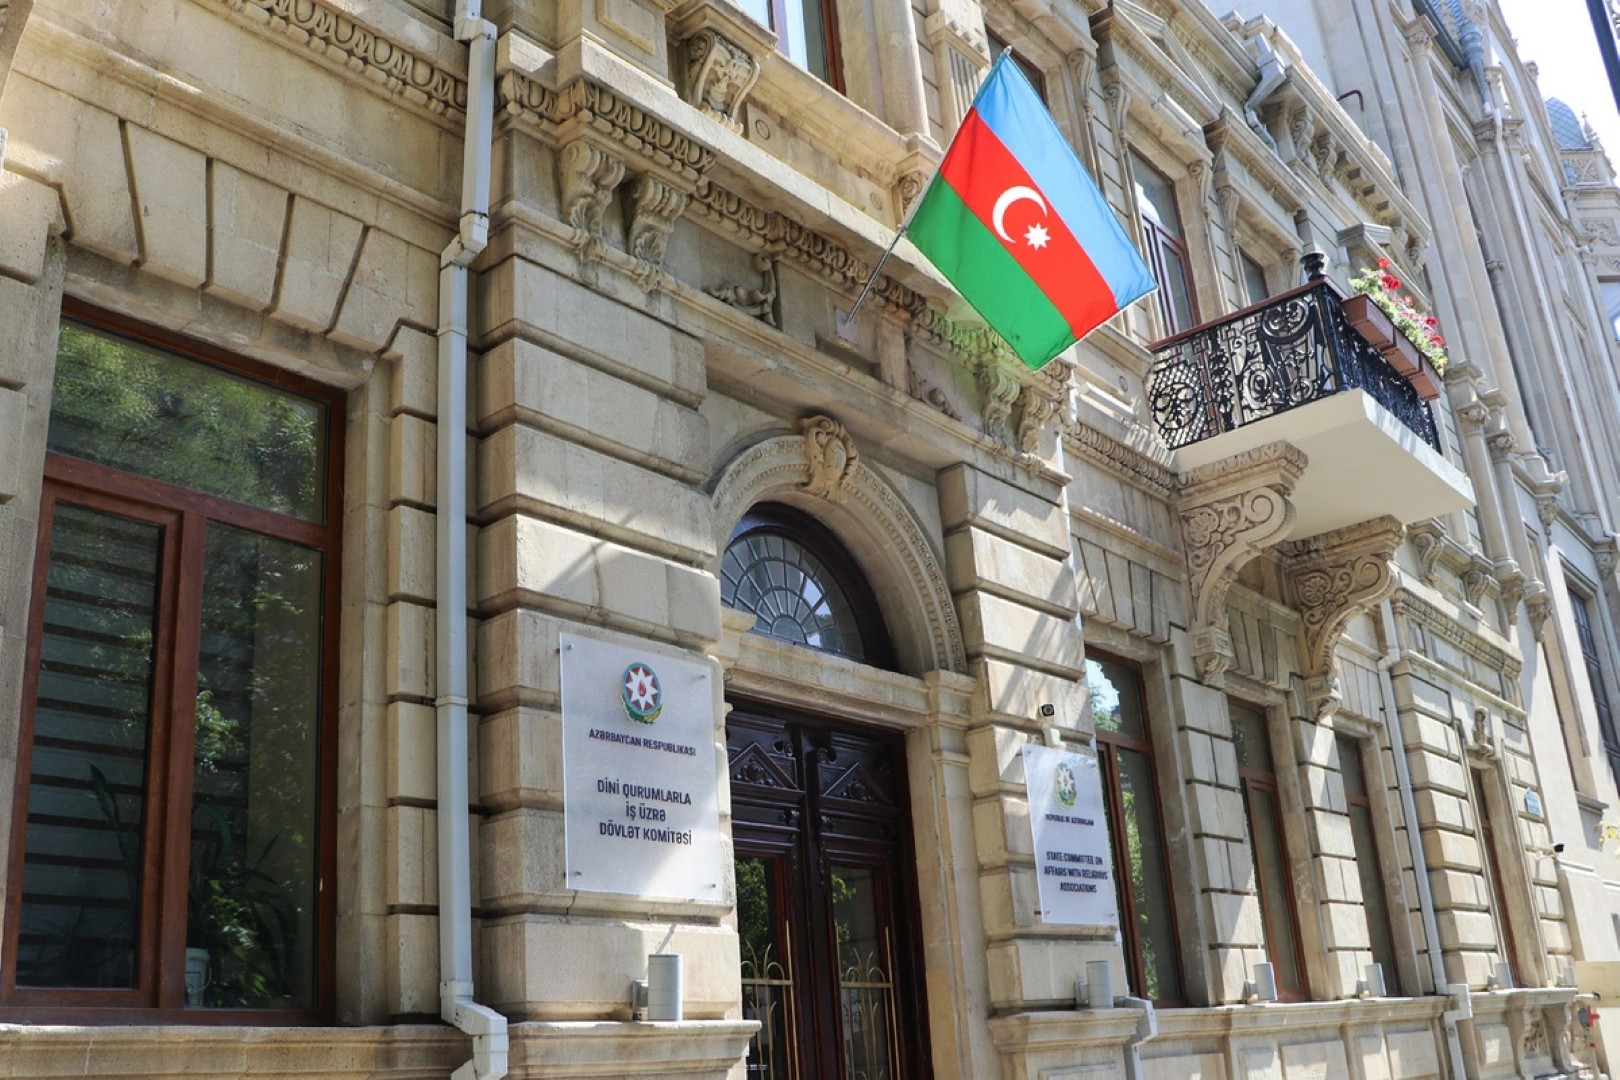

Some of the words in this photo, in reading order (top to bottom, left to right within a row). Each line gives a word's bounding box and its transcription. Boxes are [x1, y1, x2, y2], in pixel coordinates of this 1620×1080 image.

[589, 728, 641, 747] AZƏRBAYCAN
[597, 776, 620, 795] DİNİ
[622, 783, 692, 805] QURUMLARLA
[625, 801, 637, 821] İŞ
[639, 802, 666, 822] ÜZRƏ
[599, 819, 641, 839] DÖVLƏT
[643, 827, 692, 846] KOMİTƏSİ
[1046, 851, 1064, 862] STATE
[1063, 852, 1094, 865] COMMITTEE
[1095, 856, 1103, 865] ON
[1044, 866, 1067, 877] AFFAIRS
[1060, 882, 1097, 893] ASSOCIATIONS
